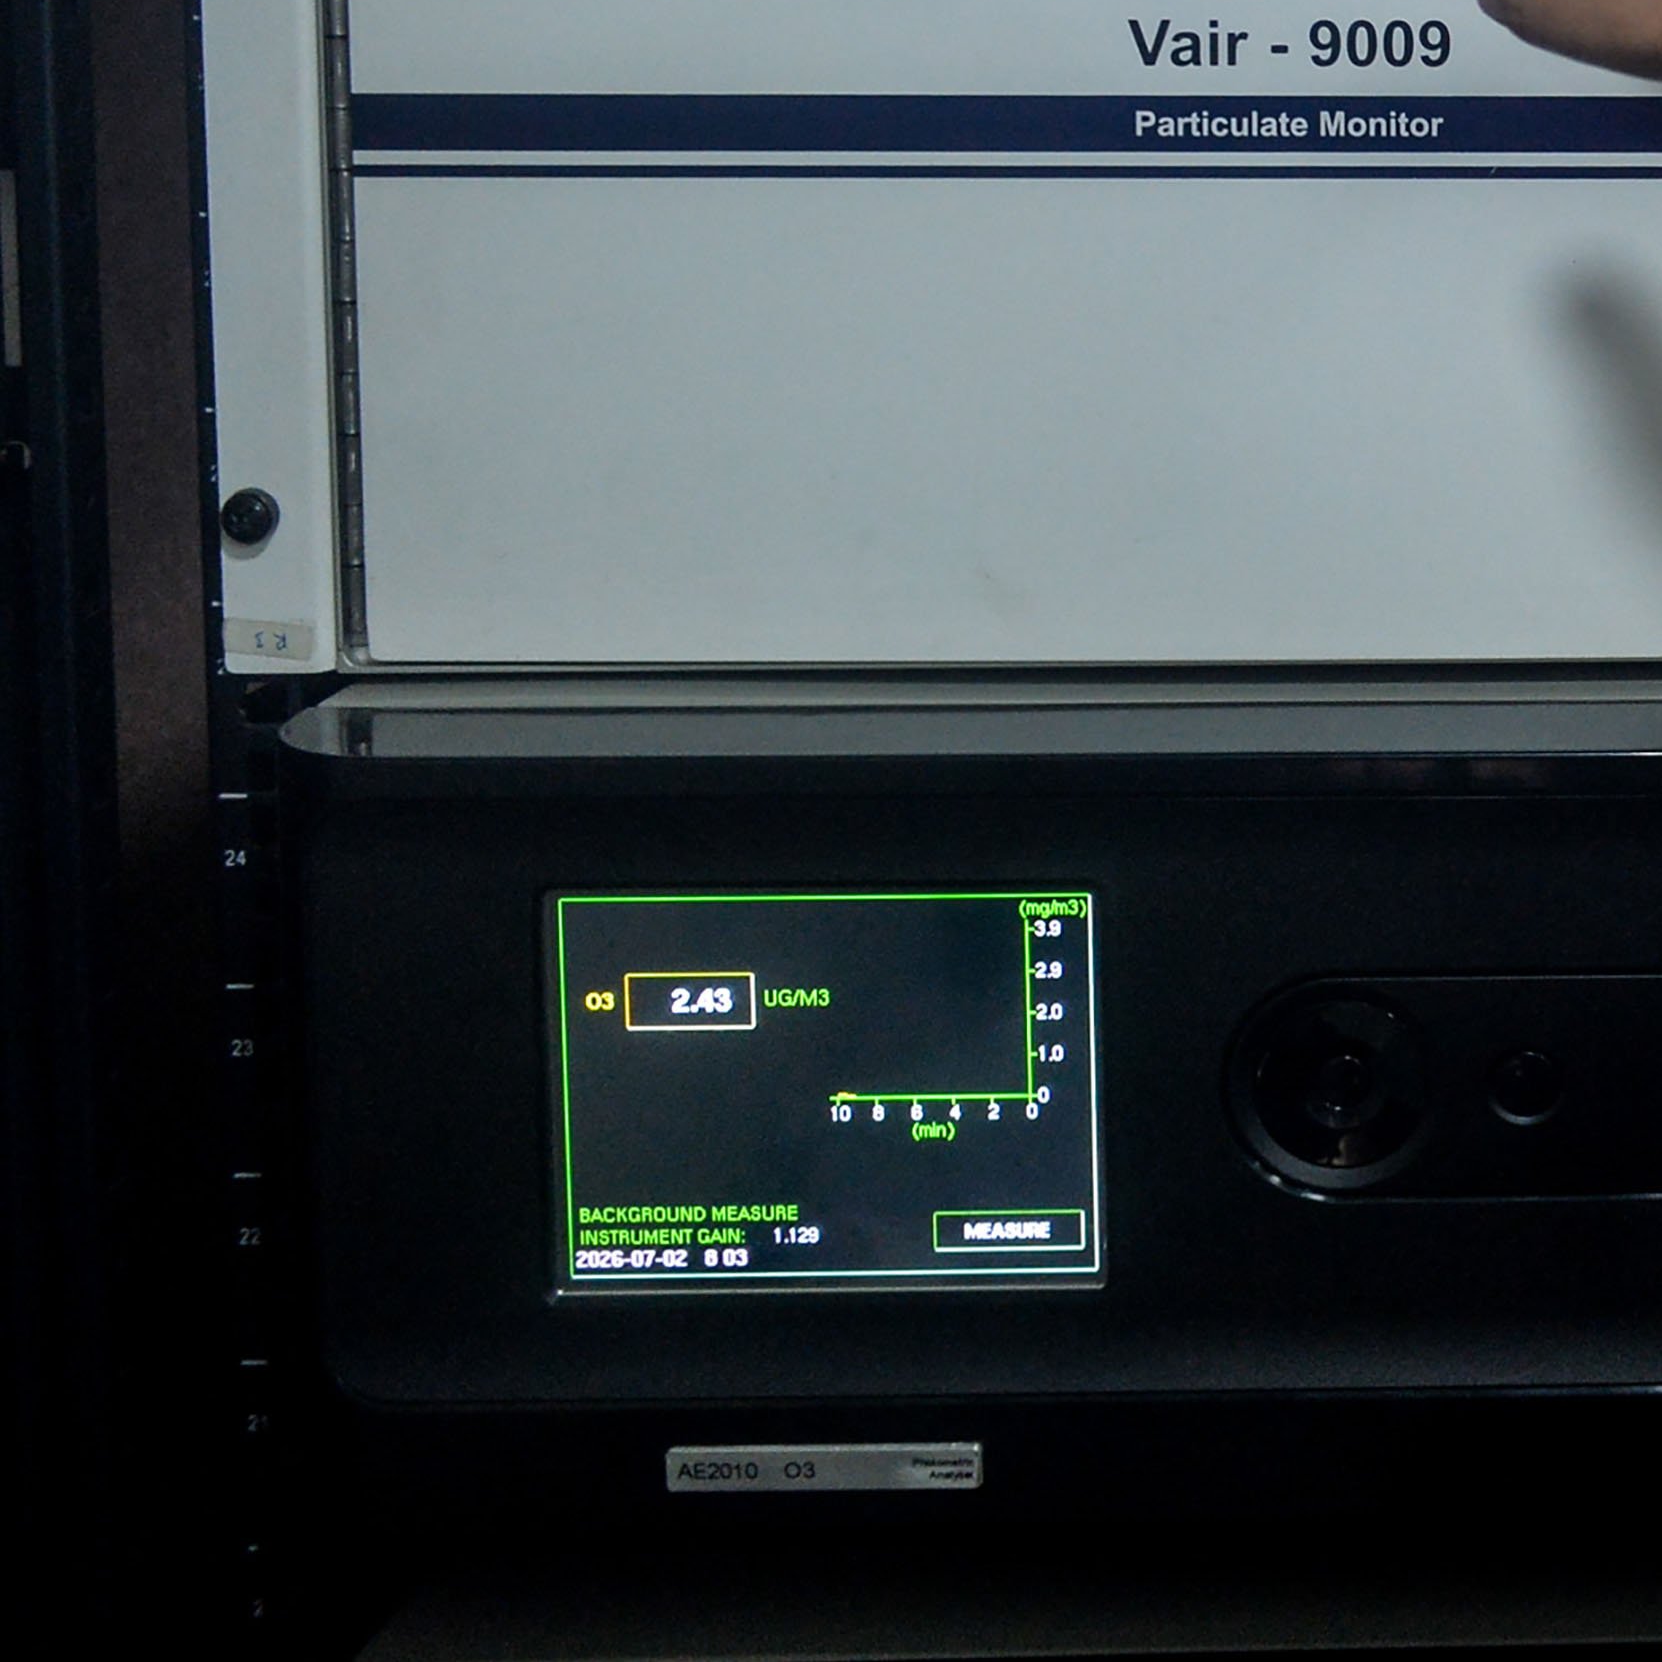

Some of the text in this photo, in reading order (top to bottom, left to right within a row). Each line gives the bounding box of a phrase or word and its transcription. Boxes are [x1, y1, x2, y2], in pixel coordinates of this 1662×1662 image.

[1127, 19, 1249, 67] Vair
[1308, 19, 1451, 67] 9009
[1134, 110, 1444, 137] Particulate Monitor
[224, 849, 247, 867] 24
[1018, 899, 1087, 919] (mg/m3)
[1033, 919, 1062, 938] 3.9
[1034, 960, 1063, 979] 2.9
[670, 987, 734, 1014] 2.43
[763, 988, 831, 1007] UG/M3
[1035, 1002, 1063, 1021] 2.0
[231, 1039, 254, 1057] 23
[1038, 1044, 1065, 1062] 1.0
[1037, 1085, 1051, 1104] 0
[830, 1104, 852, 1122] 10
[872, 1104, 885, 1122] 8
[949, 1104, 962, 1121] 4
[987, 1103, 1001, 1121] 2
[1025, 1102, 1039, 1120] 0
[911, 1121, 956, 1141] (min)
[579, 1205, 799, 1224] BACKGROUND MEASURE
[239, 1227, 261, 1246] 22
[580, 1226, 821, 1246] INSTRUMENT GAIN: 1.129
[963, 1221, 1052, 1240] MEASURE
[575, 1249, 689, 1269] 2026-07-02
[677, 1461, 816, 1481] AE2010 O3
